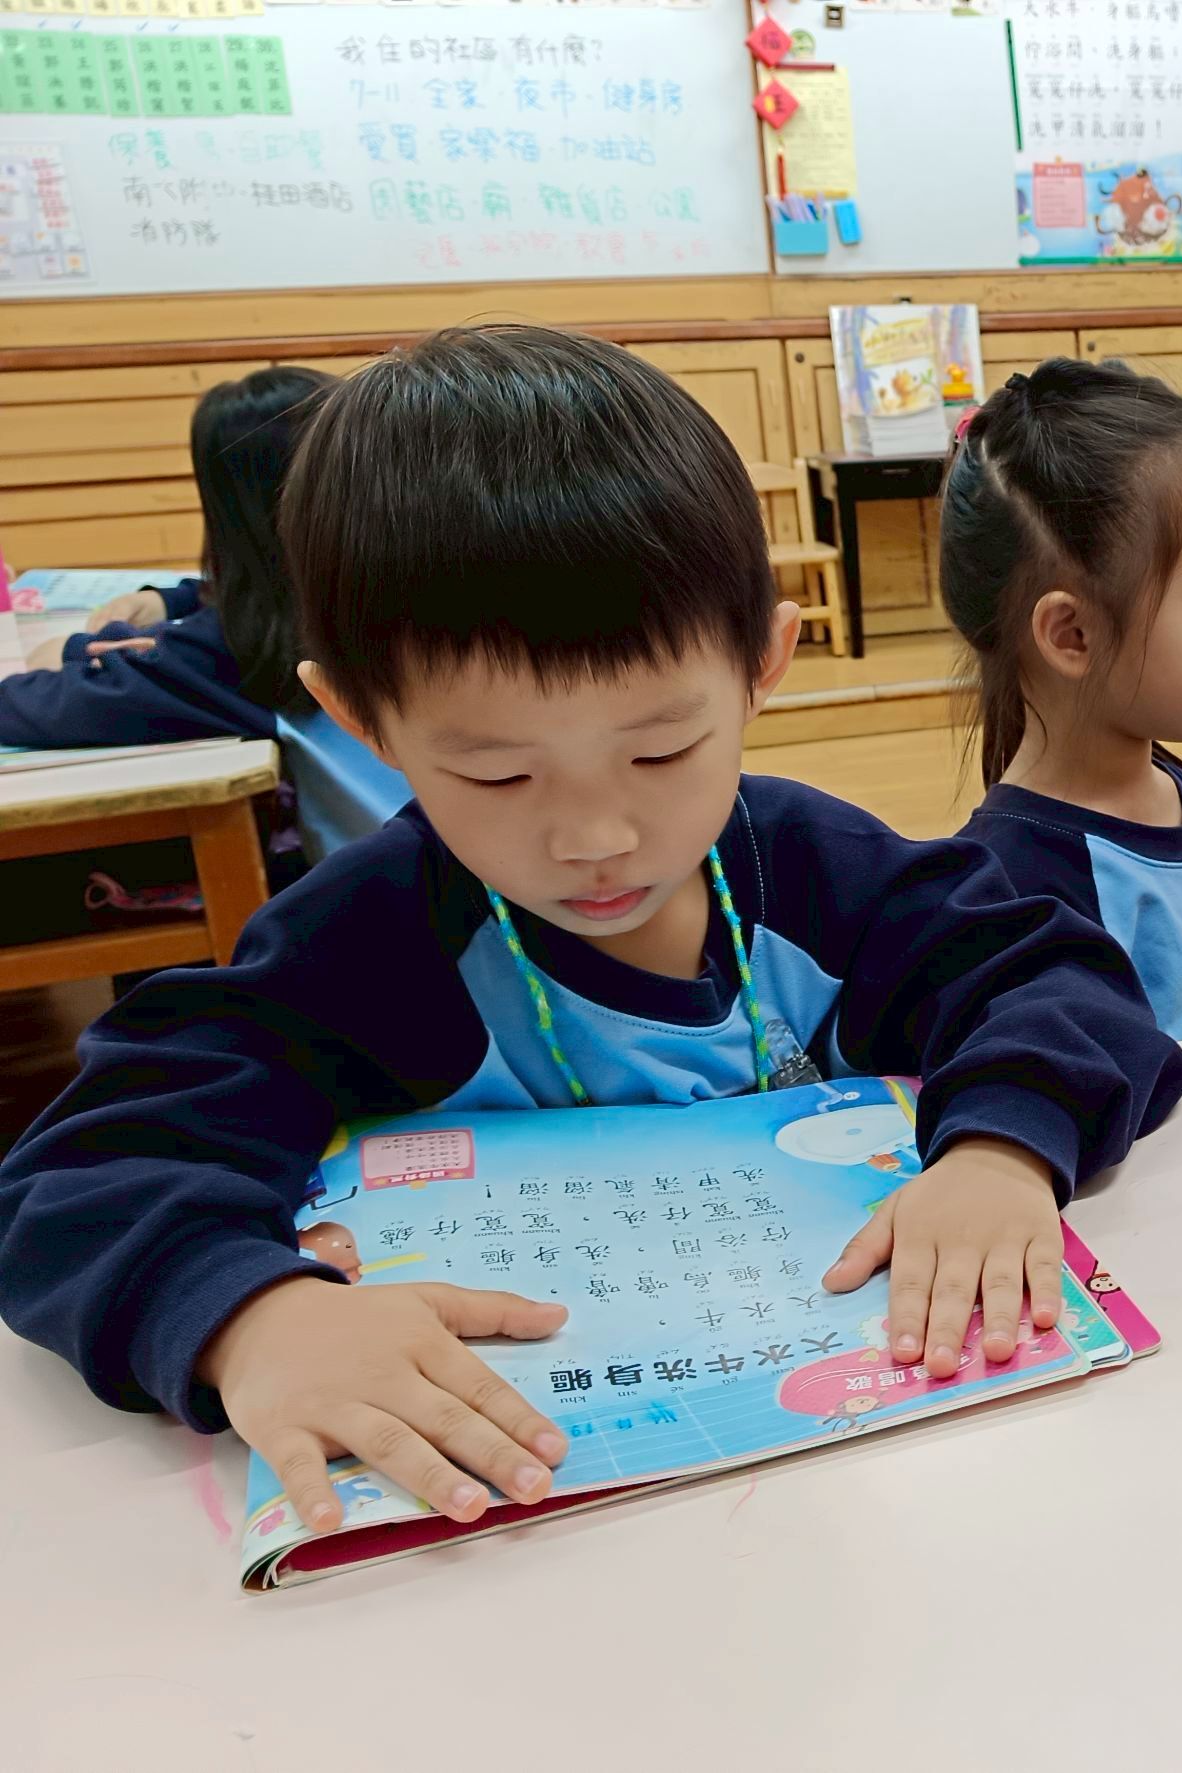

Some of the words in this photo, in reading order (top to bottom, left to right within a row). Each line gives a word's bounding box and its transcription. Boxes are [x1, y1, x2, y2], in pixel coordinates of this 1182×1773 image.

[486, 1167, 767, 1199] 洗甲清氣溜溜！
[550, 1256, 805, 1299] 身軀烏嚕嚕，
[658, 1291, 820, 1327] 大水牛，
[550, 1331, 844, 1393] 大水牛洗身軀
[559, 1395, 587, 1405] khu
